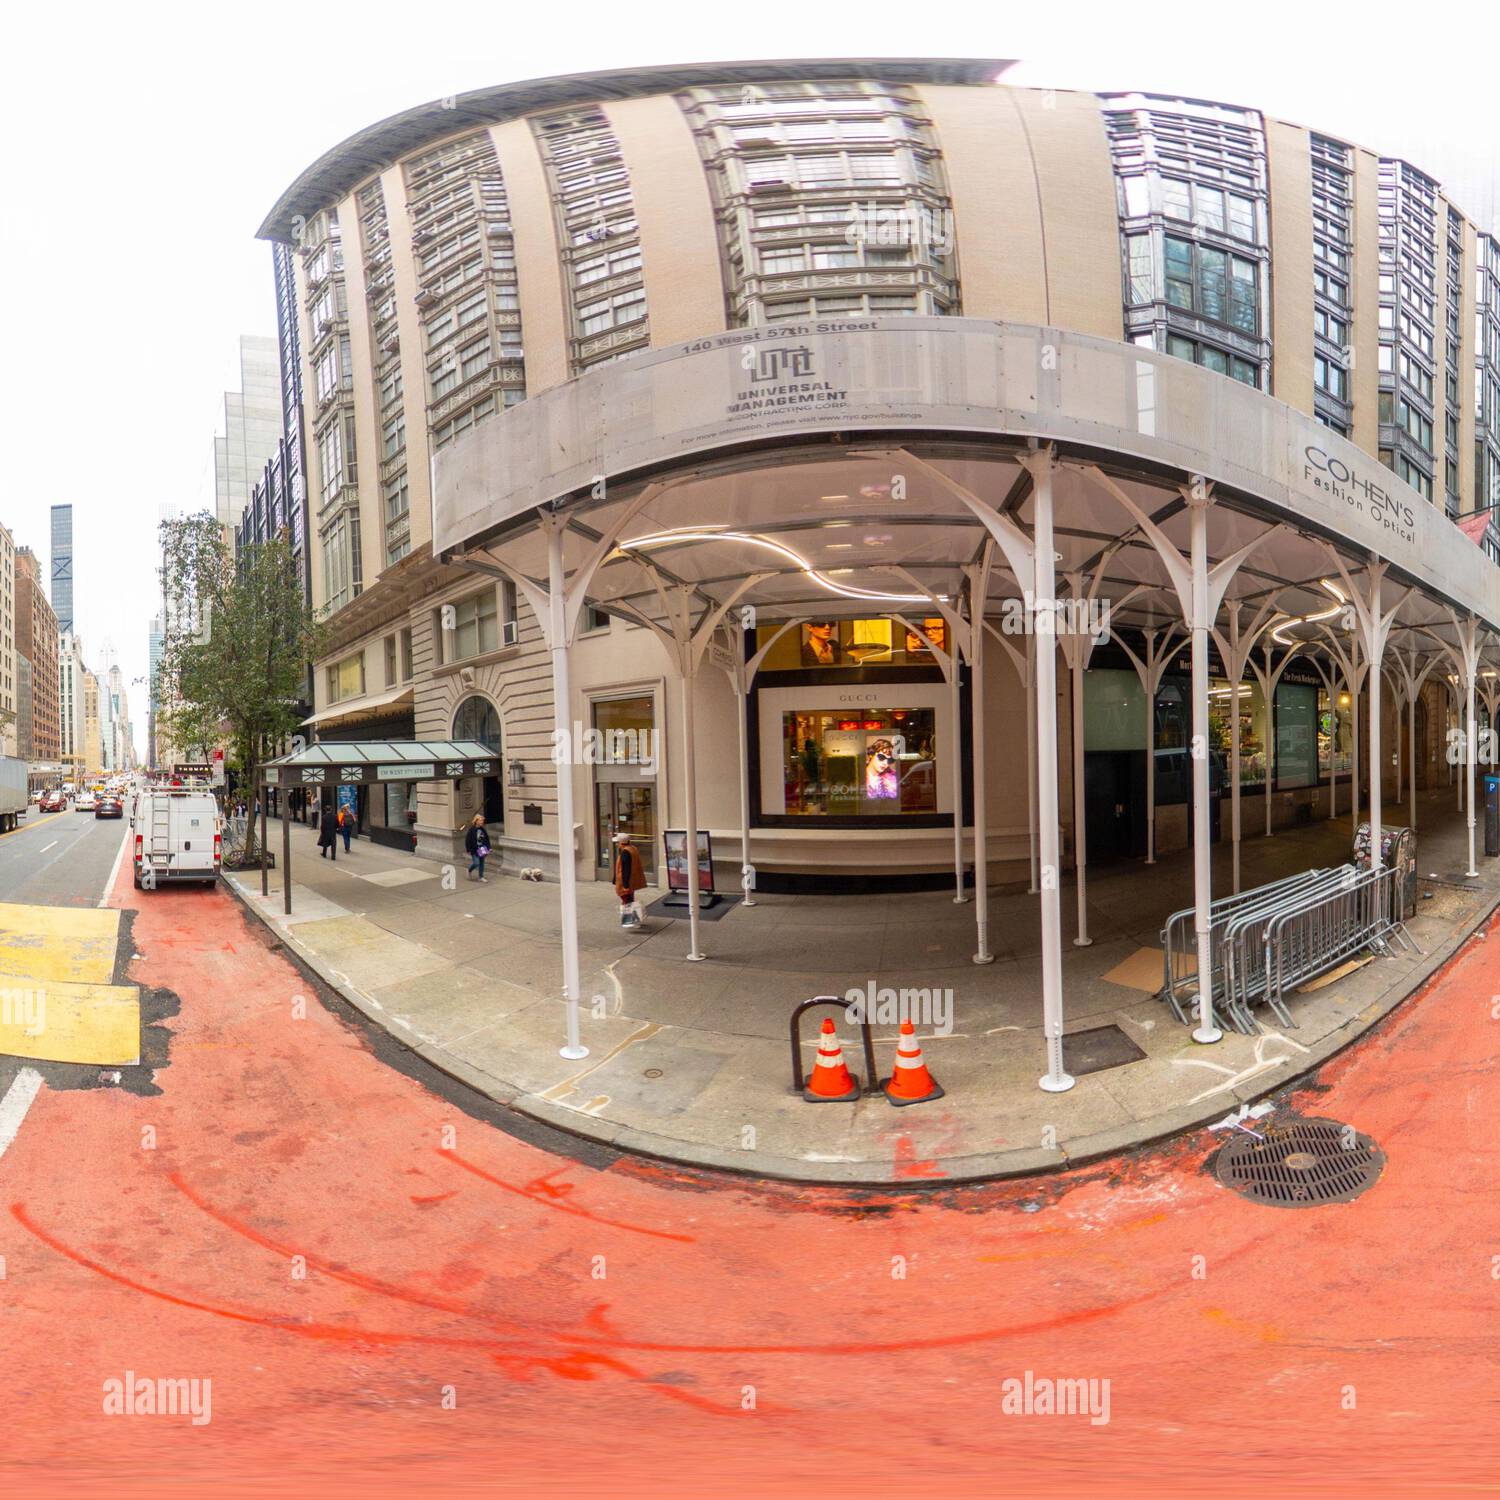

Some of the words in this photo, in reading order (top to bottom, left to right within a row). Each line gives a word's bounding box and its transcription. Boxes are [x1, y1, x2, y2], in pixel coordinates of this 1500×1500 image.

[683, 341, 712, 355] 140
[717, 332, 761, 346] West
[816, 321, 879, 333] Street
[726, 391, 848, 413] MANAGEMENT
[738, 382, 833, 401] UNIVERSAL
[1304, 446, 1415, 528] COHEN'S
[1304, 465, 1363, 511] Fashion
[1370, 506, 1416, 544] Optical
[840, 694, 877, 702] GUCCI
[1489, 782, 1496, 792] P
